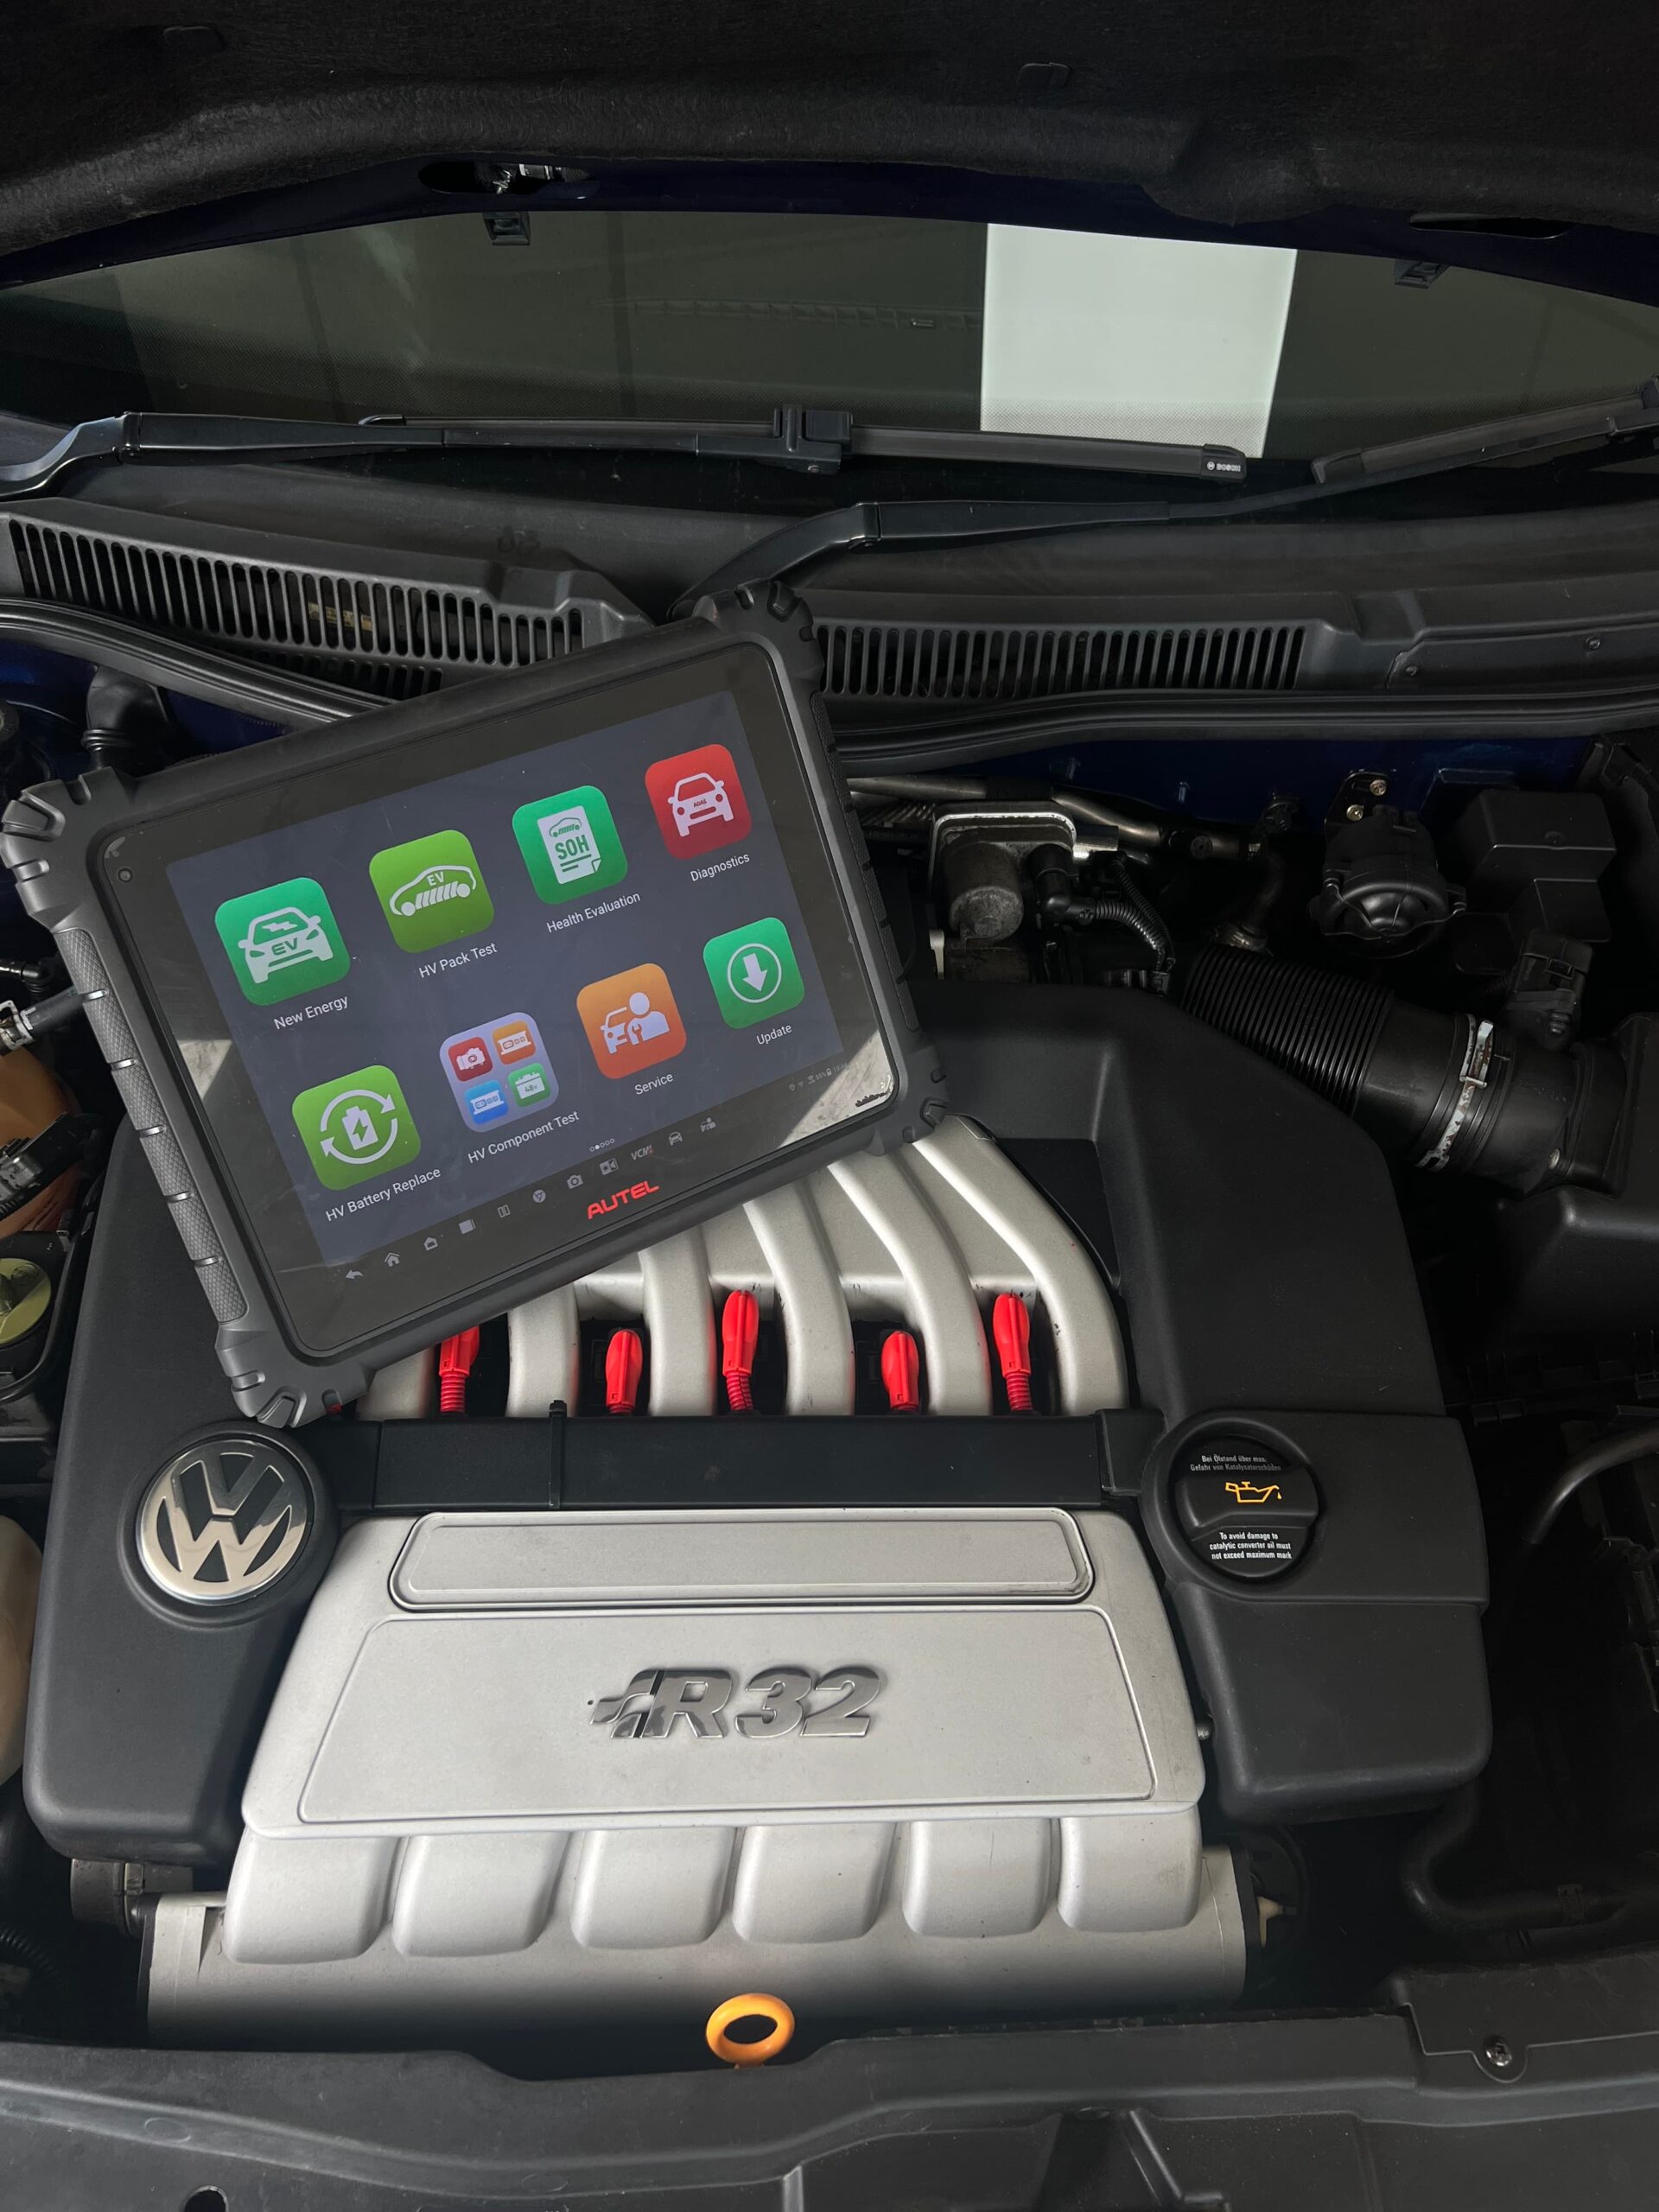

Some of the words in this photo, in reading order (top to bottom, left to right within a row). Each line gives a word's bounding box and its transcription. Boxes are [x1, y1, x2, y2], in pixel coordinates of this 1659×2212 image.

[555, 836, 590, 860] SOH
[427, 872, 445, 887] EV
[690, 852, 750, 882] Diagnostics
[546, 908, 583, 933] Health
[584, 892, 641, 921] Evaluation
[271, 938, 298, 956] EV
[419, 963, 438, 979] HV
[439, 951, 471, 973] Pack
[472, 942, 498, 961] Test
[274, 1010, 303, 1030] New
[305, 996, 349, 1020] Energy
[757, 1023, 792, 1046] Update
[634, 1072, 674, 1096] Service
[467, 1147, 486, 1163] HV
[488, 1122, 554, 1155] Component
[554, 1110, 580, 1128] Test
[325, 1205, 345, 1222] HV
[347, 1188, 391, 1213] Battery
[392, 1168, 442, 1195] Replace
[587, 1180, 660, 1220] AUTEL
[1210, 1541, 1236, 1550] catalytic
[608, 1666, 881, 1738] R32
